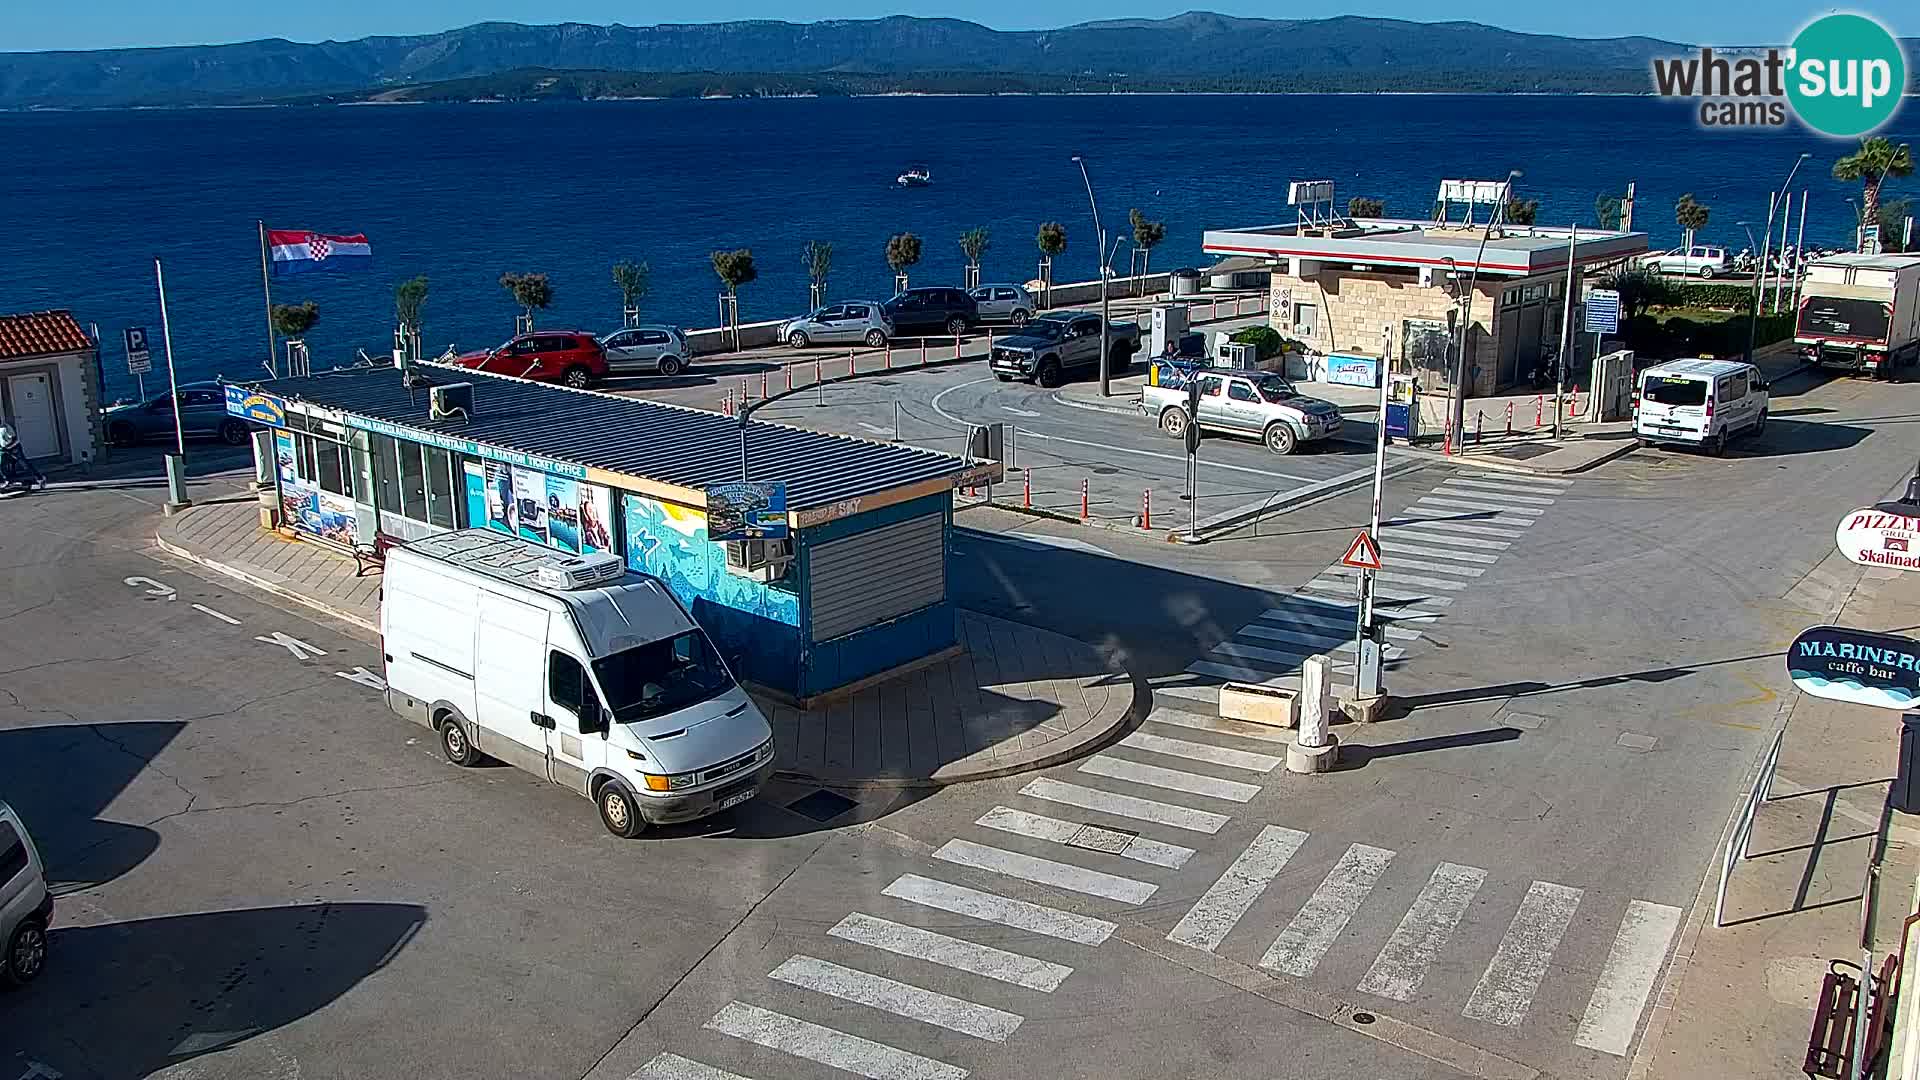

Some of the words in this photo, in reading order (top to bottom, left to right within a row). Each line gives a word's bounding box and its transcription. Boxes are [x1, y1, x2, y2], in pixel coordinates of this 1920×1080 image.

[130, 331, 142, 349] P
[477, 443, 493, 456] BUS
[494, 448, 526, 465] STATION
[527, 456, 554, 471] TICKET
[555, 462, 582, 477] OFFICE
[1881, 529, 1918, 540] GRILL
[1828, 660, 1864, 675] caffe
[1868, 664, 1896, 680] bar
